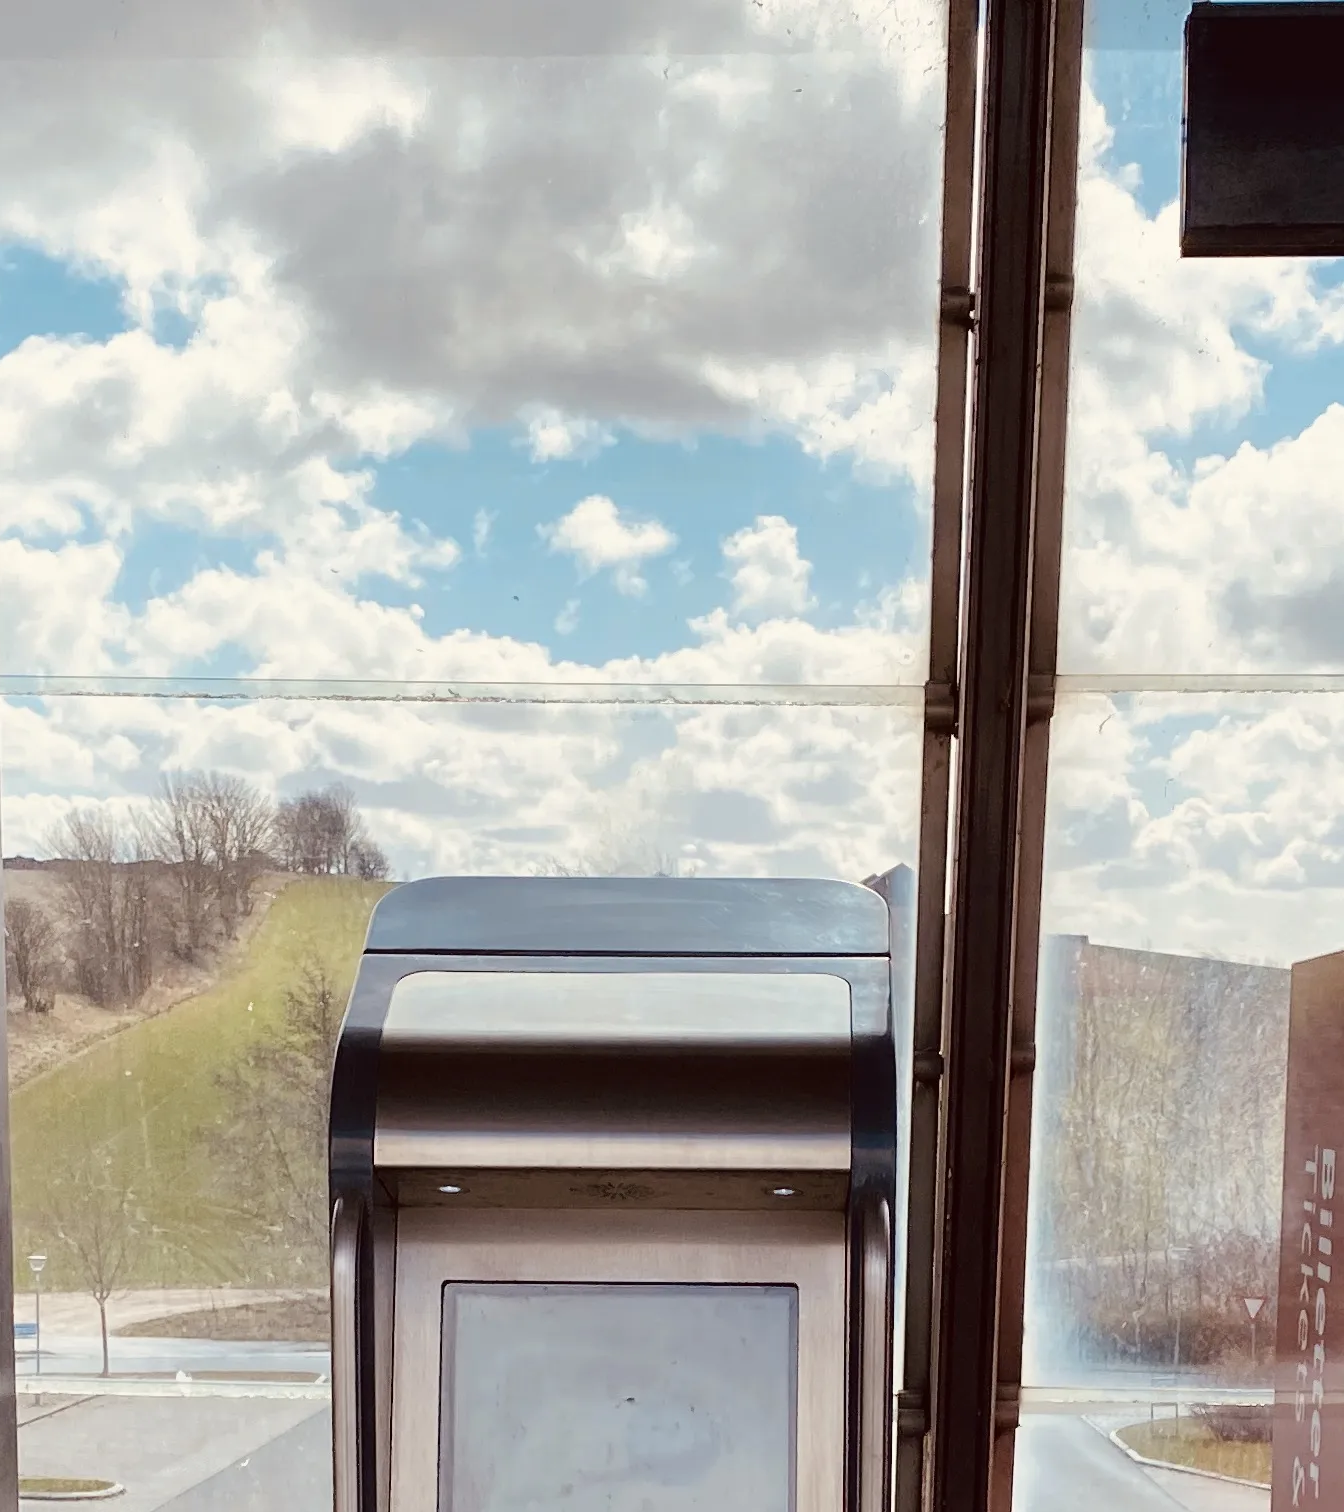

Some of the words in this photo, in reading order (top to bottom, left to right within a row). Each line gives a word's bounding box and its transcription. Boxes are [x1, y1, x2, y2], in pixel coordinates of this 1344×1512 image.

[1293, 1144, 1320, 1424] Tickets
[1308, 1147, 1337, 1500] Billetter
[1291, 1455, 1306, 1507] &
